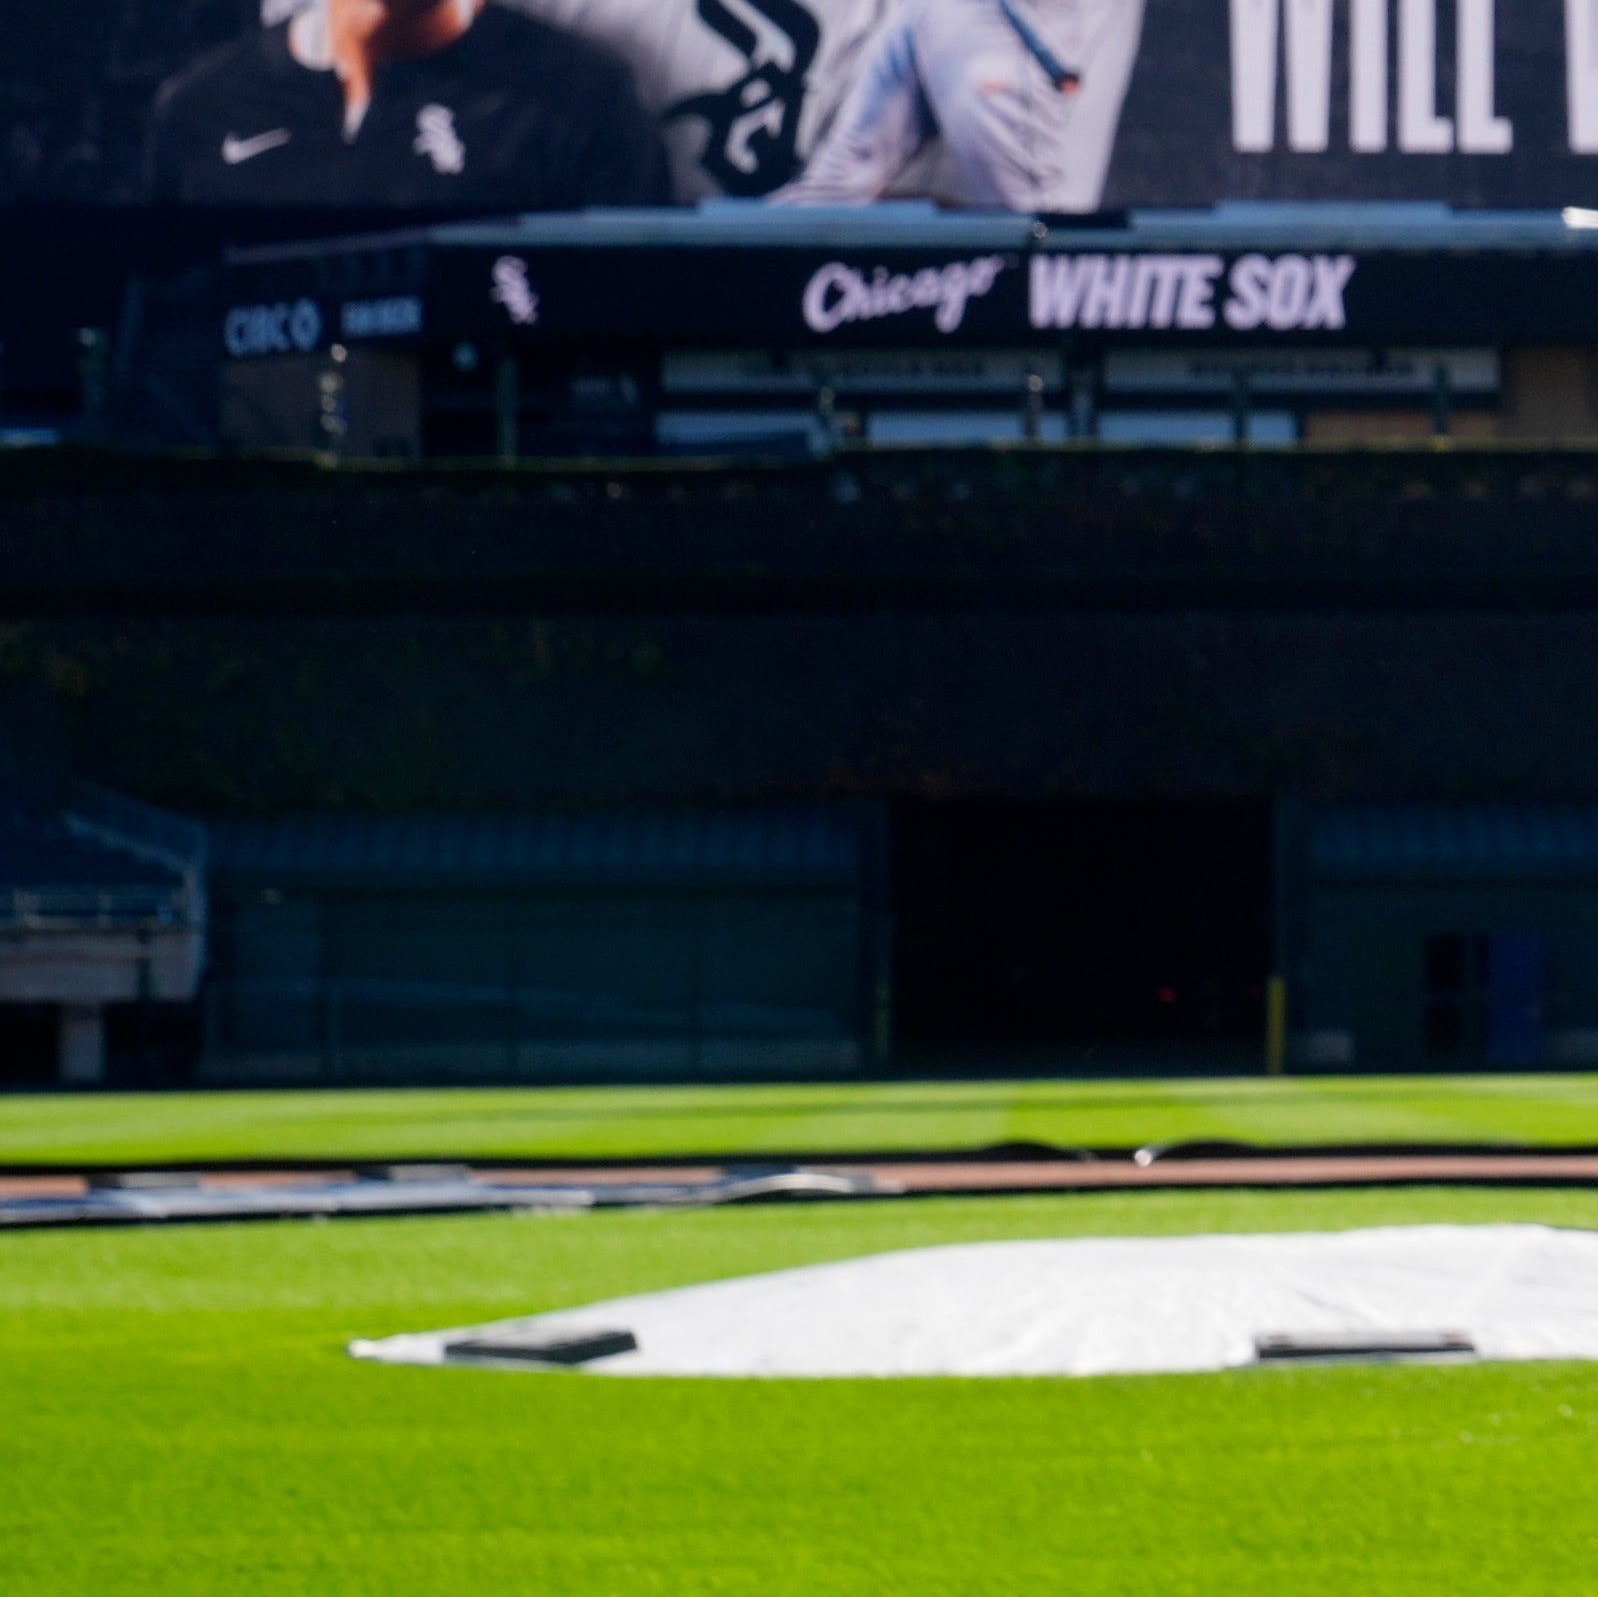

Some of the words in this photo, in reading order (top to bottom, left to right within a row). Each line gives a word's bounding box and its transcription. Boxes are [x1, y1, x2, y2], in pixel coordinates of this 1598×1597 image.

[803, 256, 1004, 333] Chicago
[1028, 255, 1223, 330] WHITE
[1223, 255, 1356, 330] SOX
